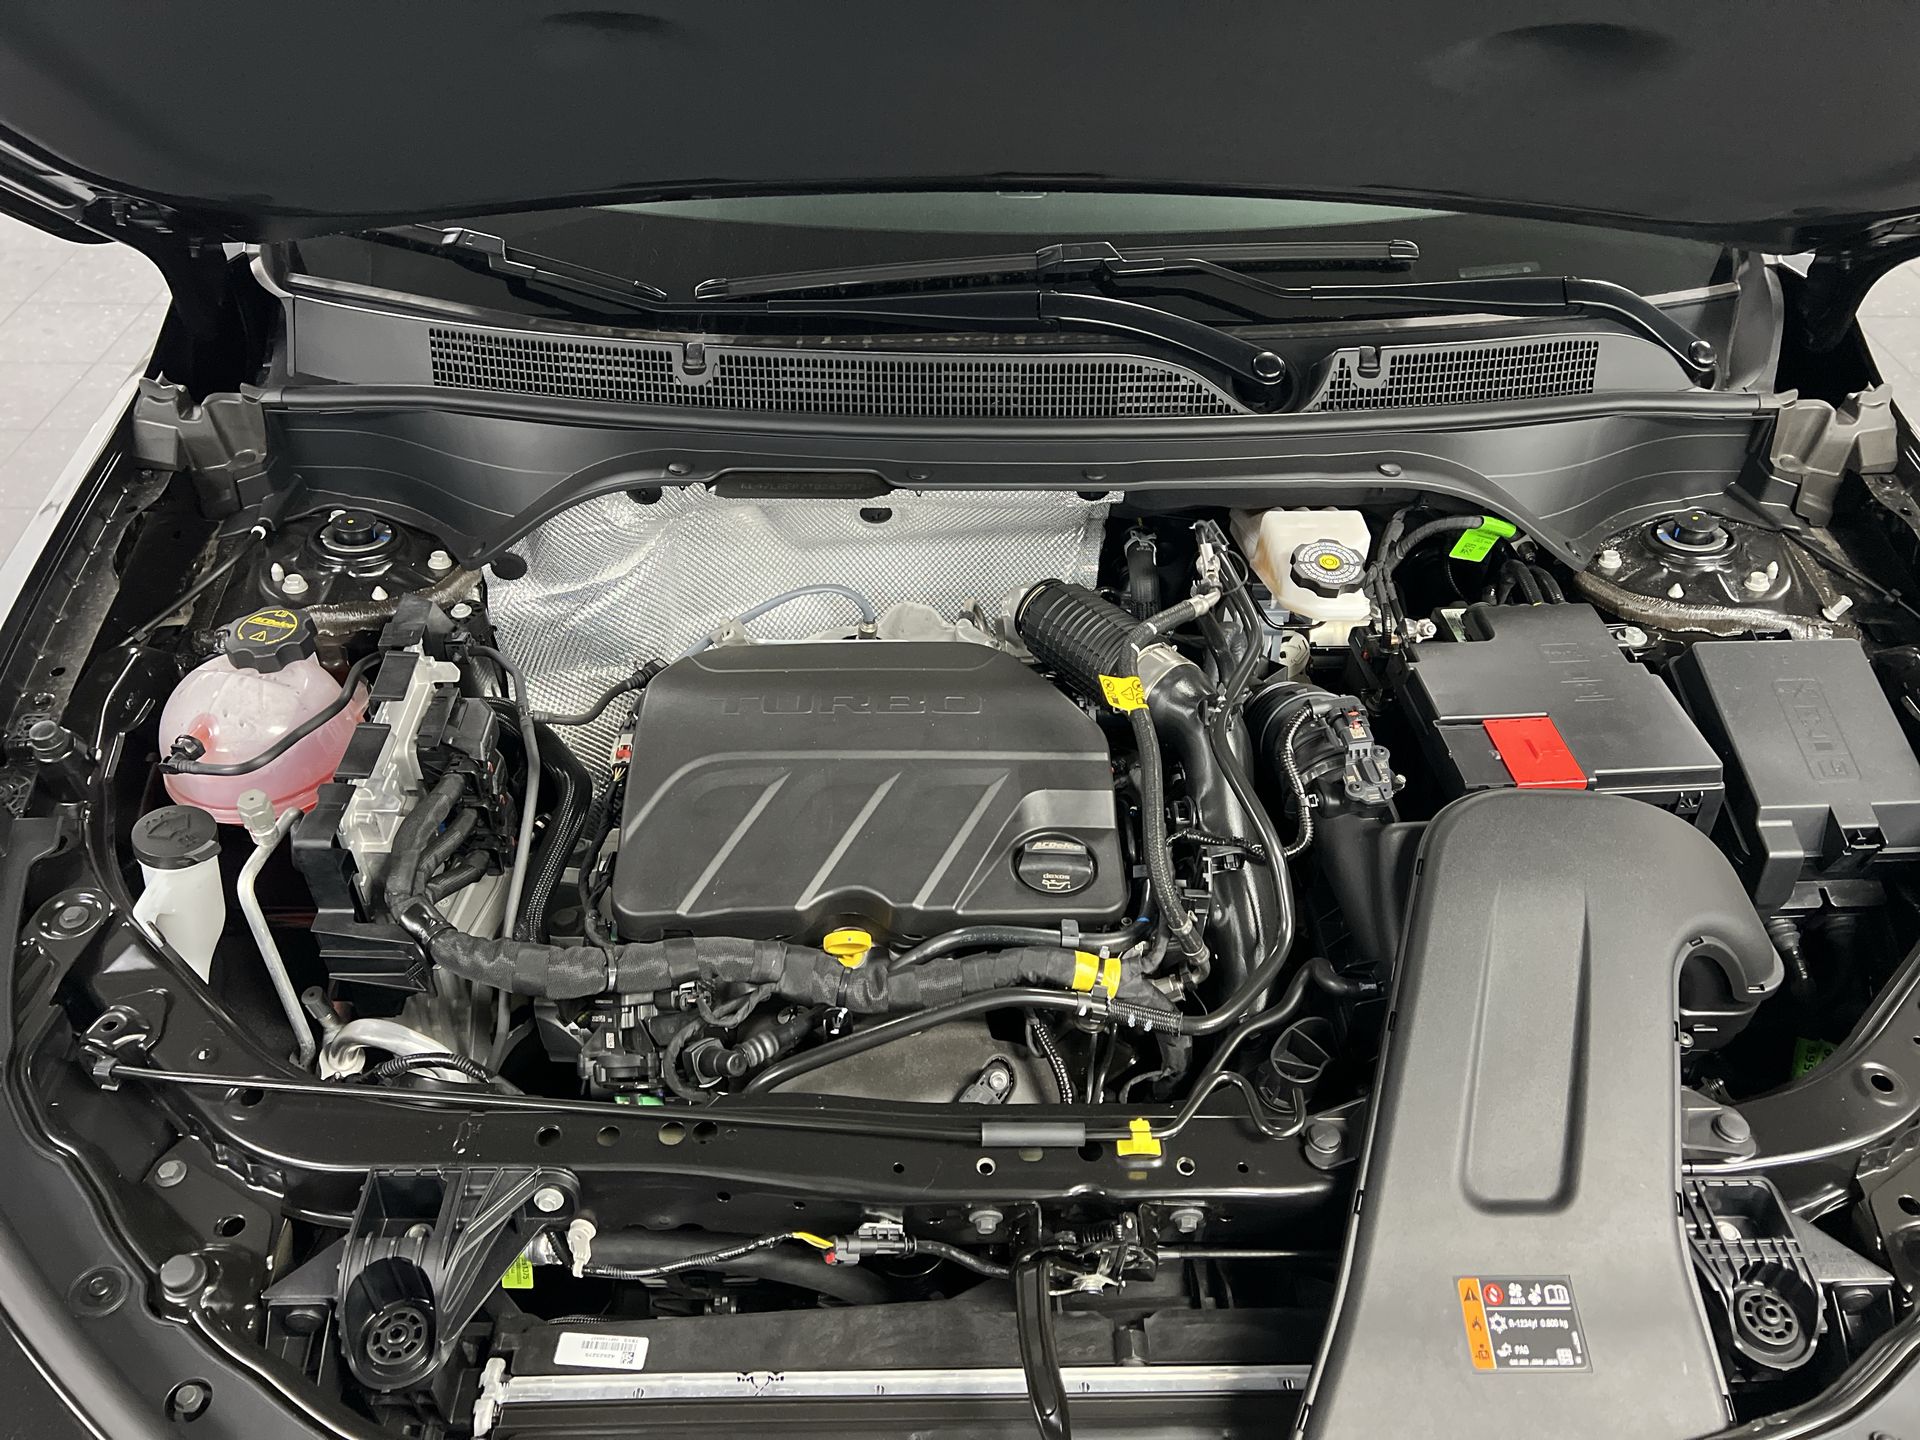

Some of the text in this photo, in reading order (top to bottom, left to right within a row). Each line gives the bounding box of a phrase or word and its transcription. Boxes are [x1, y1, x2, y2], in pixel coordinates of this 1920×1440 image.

[710, 693, 984, 715] TURBO
[1031, 841, 1082, 850] ACDelco
[1042, 872, 1071, 880] dexos
